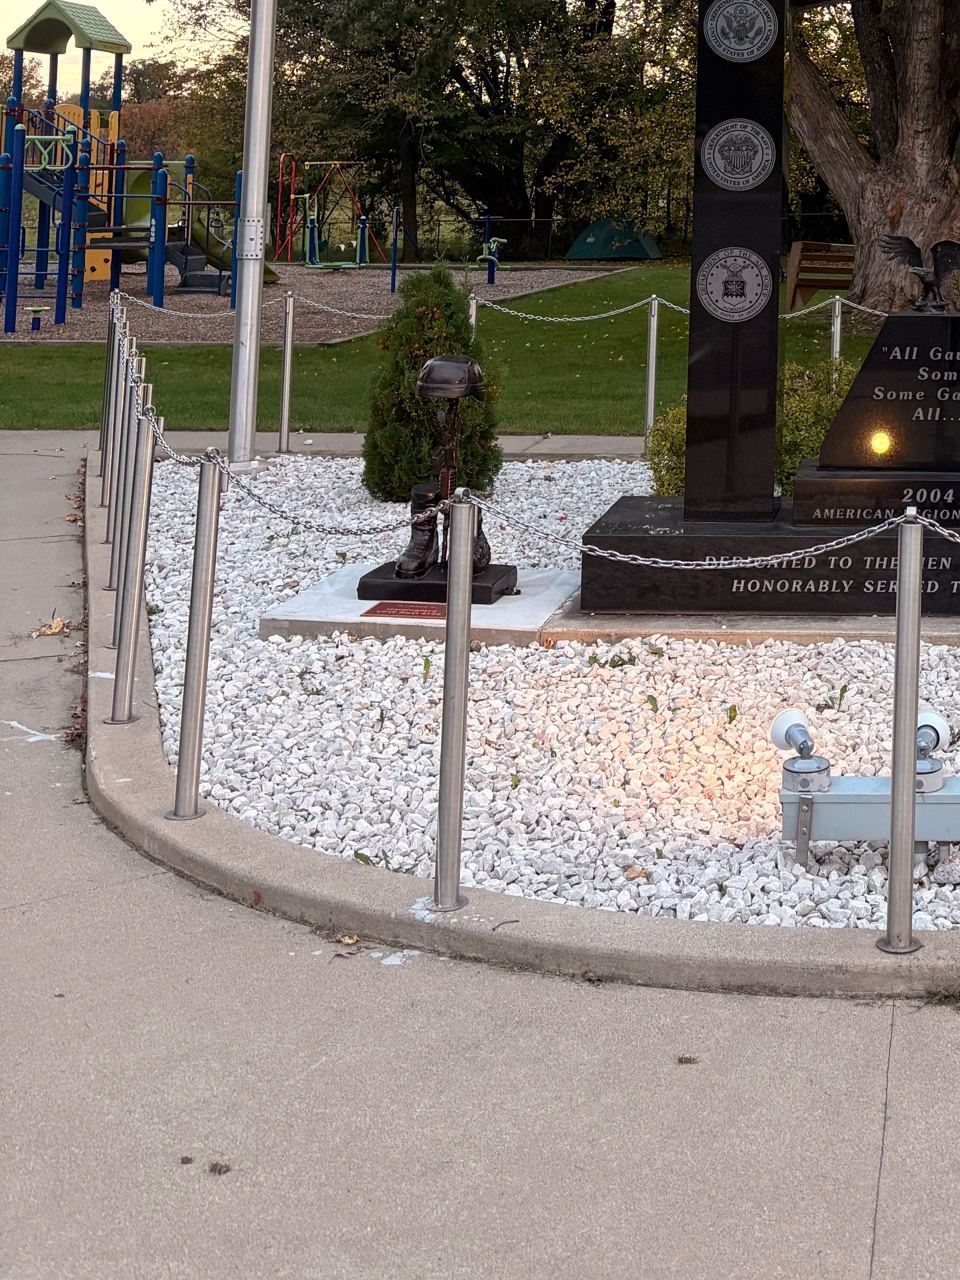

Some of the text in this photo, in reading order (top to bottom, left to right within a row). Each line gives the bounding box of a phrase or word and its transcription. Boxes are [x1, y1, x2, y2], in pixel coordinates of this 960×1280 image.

[752, 0, 764, 8] THE
[761, 7, 773, 24] ARMY
[709, 26, 723, 49] UNITED
[722, 47, 745, 57] STATES
[756, 28, 773, 53] AMERICA
[707, 123, 738, 151] DEPARTMENT
[750, 127, 761, 136] THE
[760, 135, 770, 150] NAVY
[706, 157, 721, 178] UNITED
[720, 176, 741, 186] STATES
[751, 159, 770, 181] AMERICA
[699, 254, 721, 296] DEPARTMENT
[738, 250, 753, 259] THE
[754, 259, 765, 271] AIR
[761, 274, 769, 298] FORCE
[882, 346, 918, 360] "All
[872, 386, 925, 400] Some
[901, 488, 955, 503] 2004
[812, 508, 895, 520] AMERICAN
[828, 556, 853, 569] TO
[863, 556, 899, 570] THE
[921, 556, 952, 570] EN
[731, 579, 854, 593] HONORABLY
[863, 580, 939, 594] SERD
